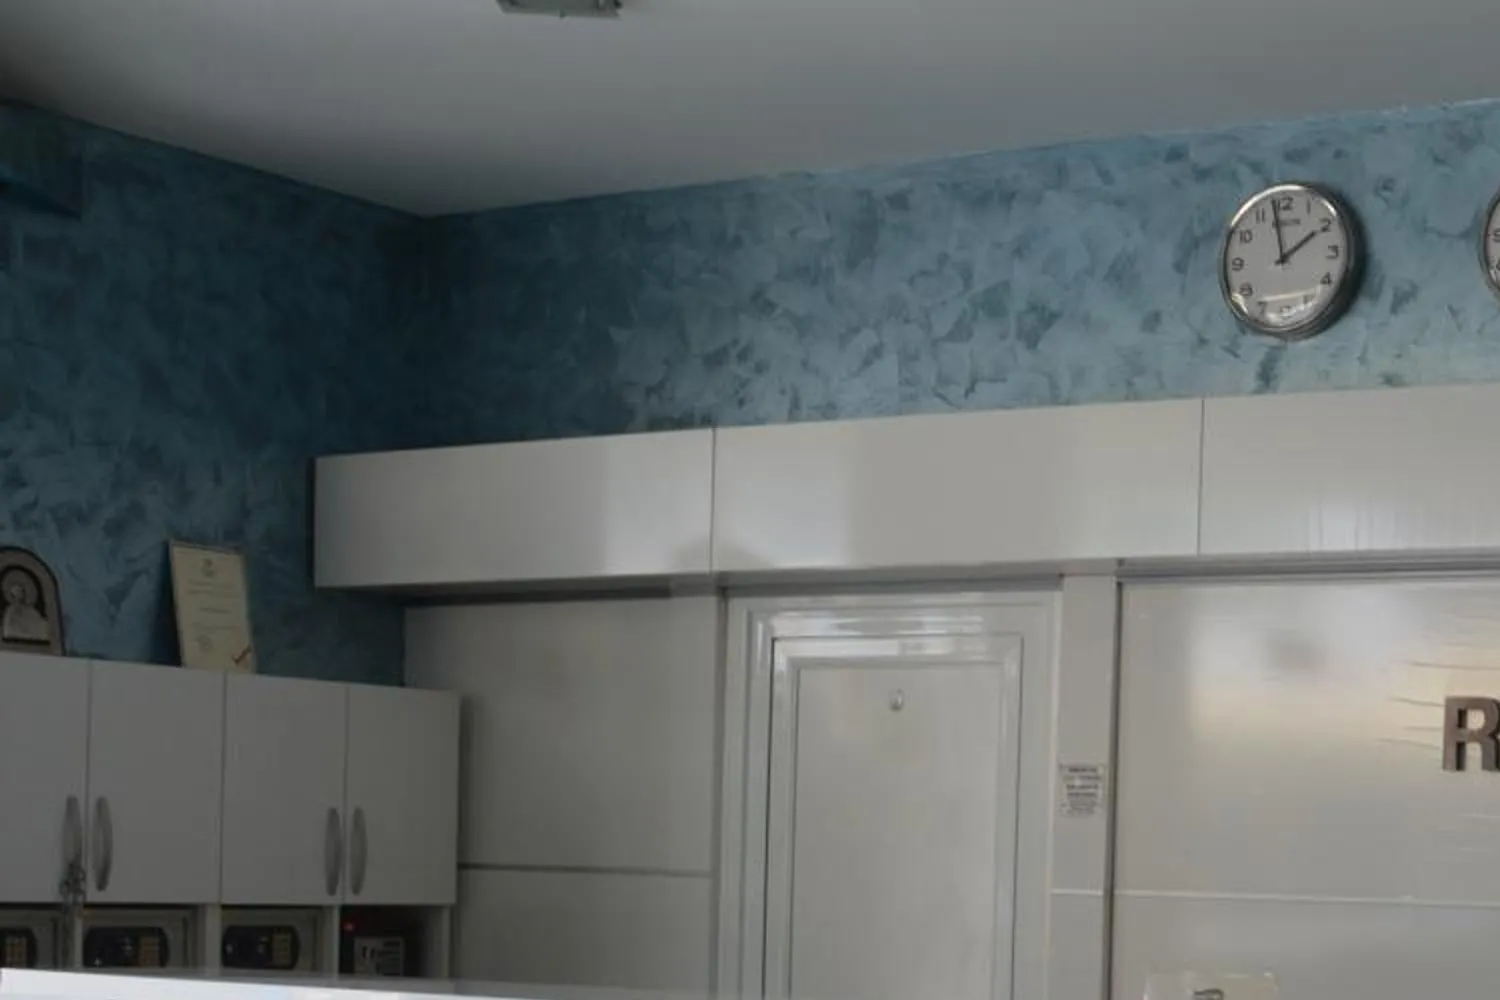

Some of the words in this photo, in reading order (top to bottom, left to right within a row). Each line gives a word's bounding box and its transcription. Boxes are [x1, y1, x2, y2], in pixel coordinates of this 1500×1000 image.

[1277, 197, 1294, 211] 12
[1255, 210, 1266, 224] 11
[1320, 217, 1332, 233] 2
[1239, 230, 1253, 243] 10
[1327, 245, 1340, 260] 3
[1231, 257, 1245, 272] 9
[1320, 271, 1333, 286] 4
